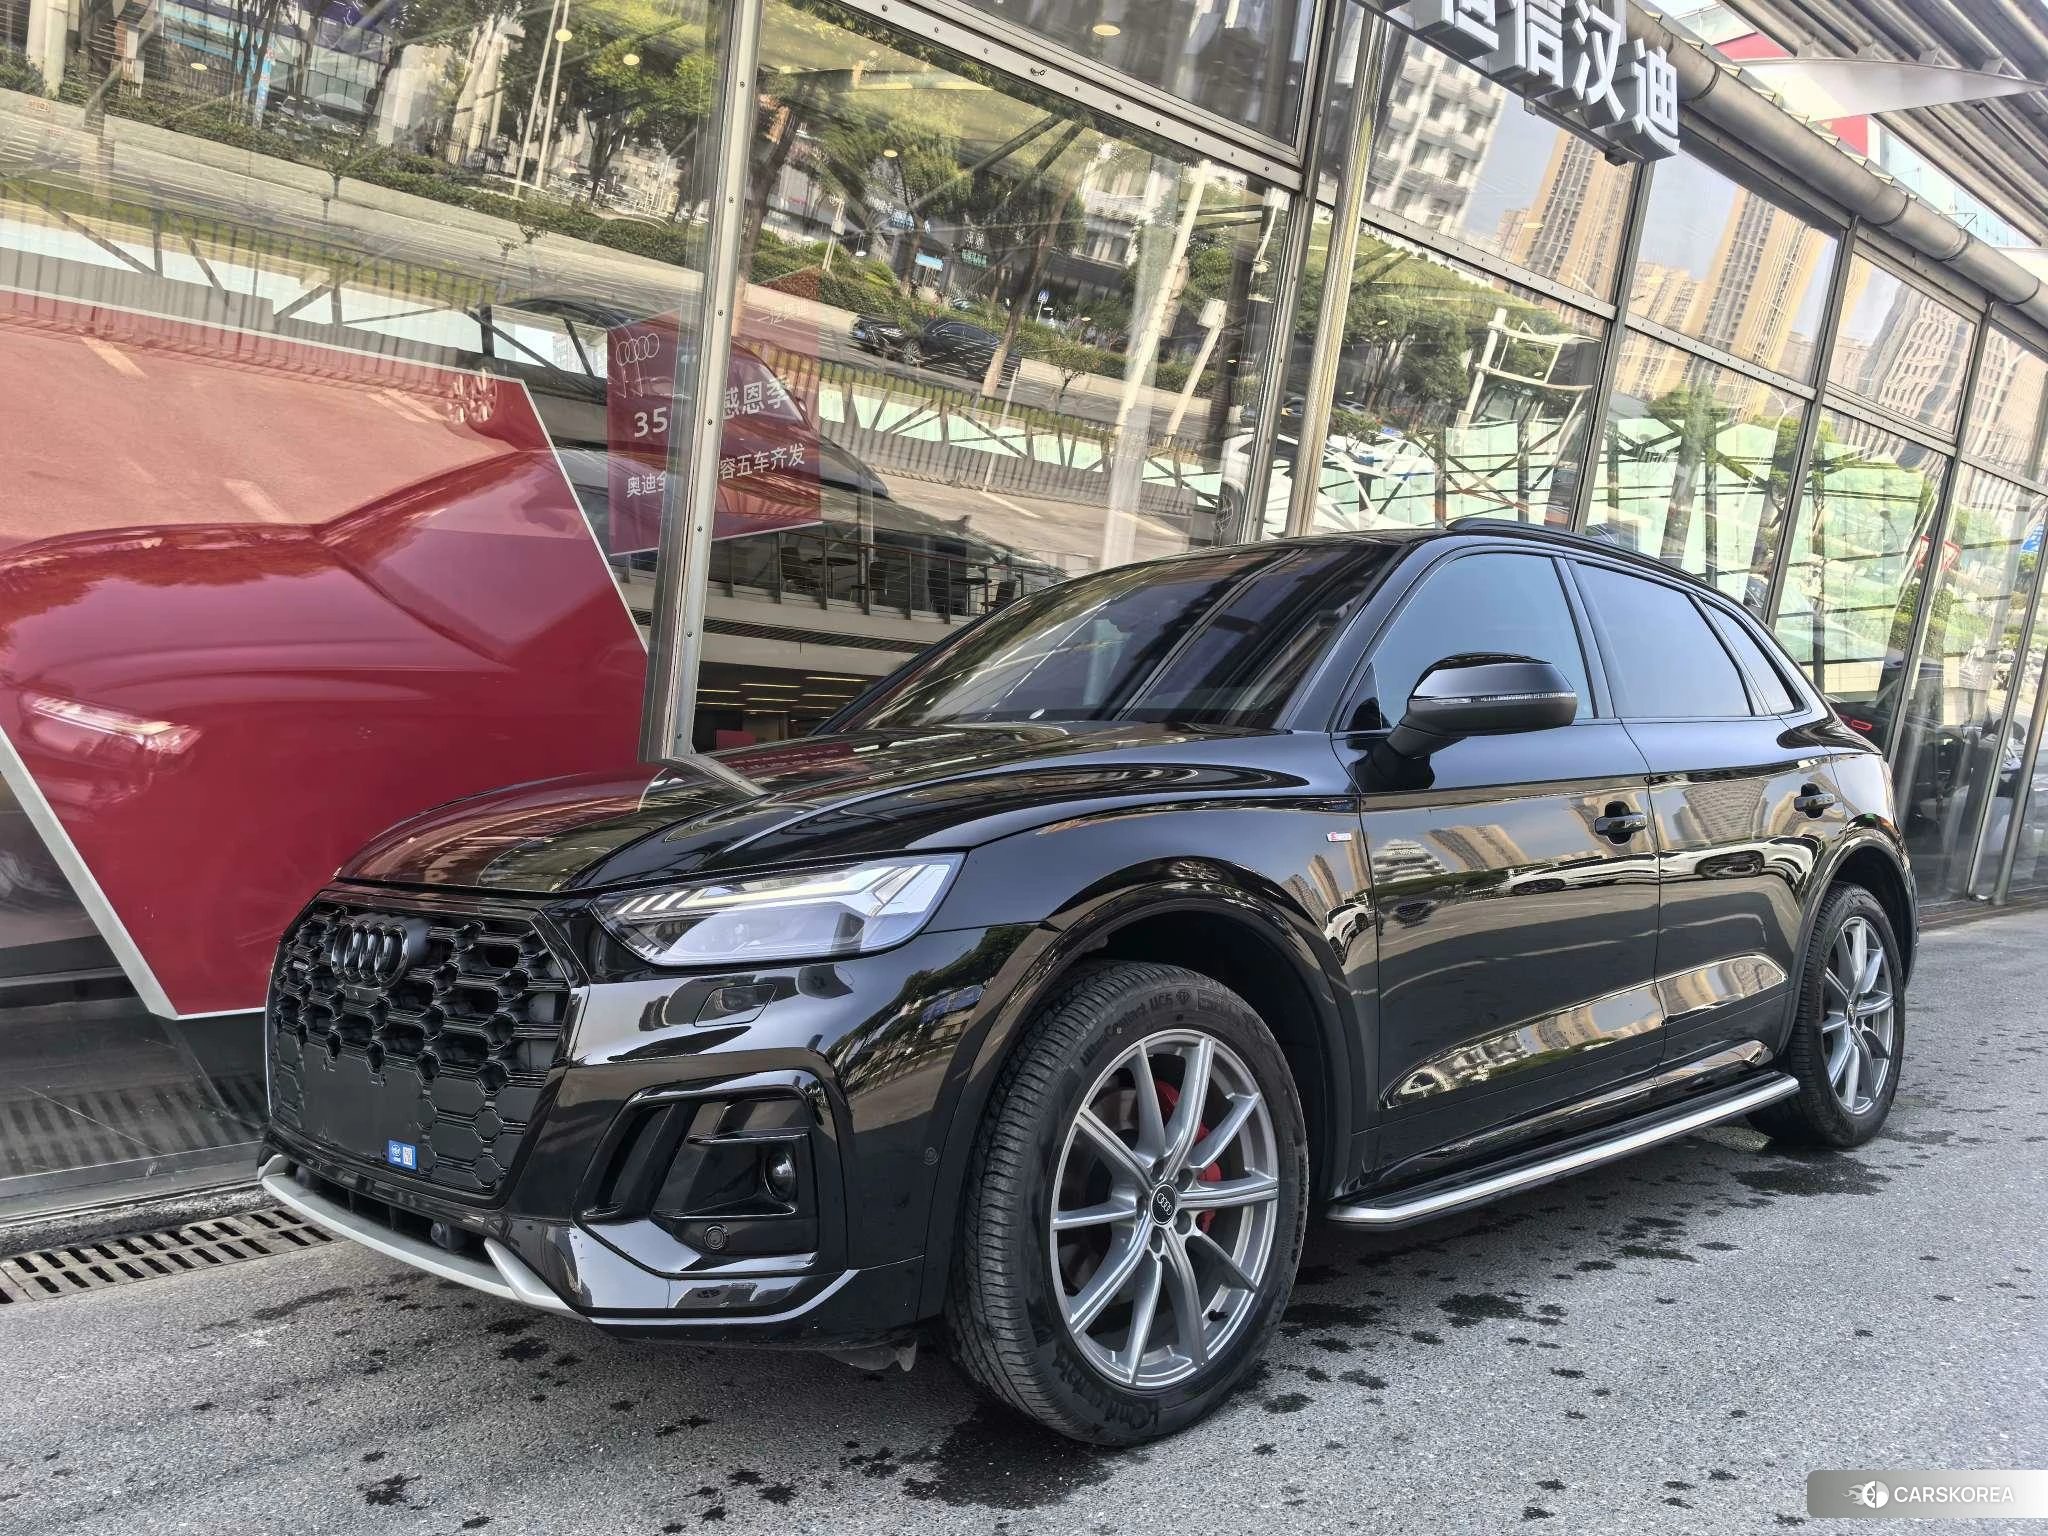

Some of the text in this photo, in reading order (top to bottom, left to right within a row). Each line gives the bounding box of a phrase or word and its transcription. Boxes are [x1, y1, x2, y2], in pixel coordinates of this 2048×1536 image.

[633, 406, 668, 438] 35
[719, 443, 806, 480] 容五车齐发
